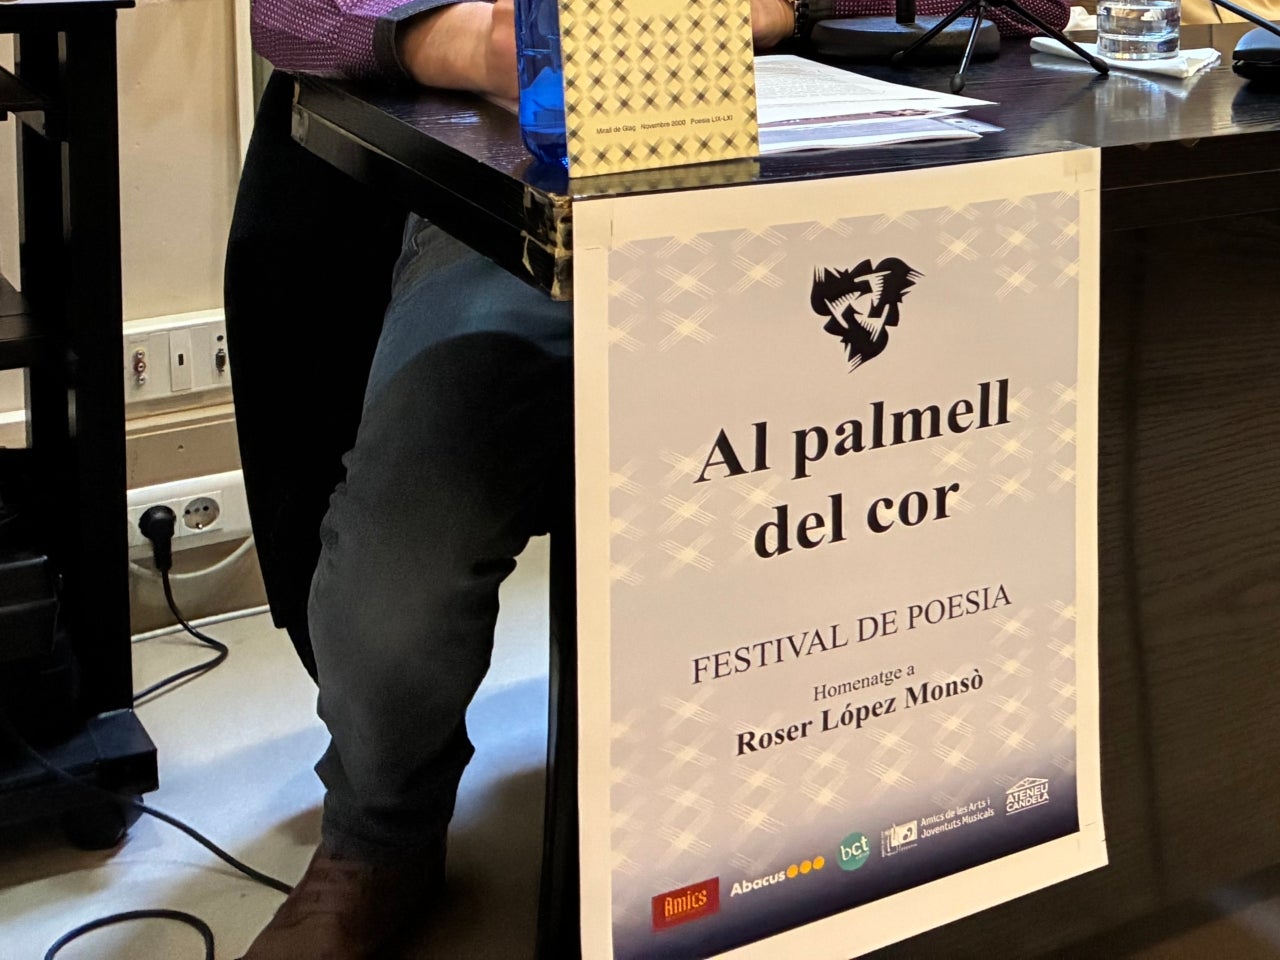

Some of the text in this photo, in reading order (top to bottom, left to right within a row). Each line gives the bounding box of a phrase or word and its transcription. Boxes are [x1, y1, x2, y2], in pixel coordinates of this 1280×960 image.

[640, 122, 670, 130] Novembre
[692, 378, 1010, 484] Al palmell
[753, 482, 960, 559] del cor
[691, 583, 1013, 685] FESTIVAL DE POESIA
[813, 665, 915, 701] Homenatge a
[735, 668, 984, 757] Roser López Monsò
[1006, 783, 1049, 804] ATENEU
[1006, 792, 1050, 812] CANDELA
[920, 796, 991, 827] Amics de les Arts i
[920, 807, 995, 839] Joventuts Musicals
[840, 835, 869, 861] bct
[730, 870, 786, 897] Abacus
[664, 889, 707, 917] Amics
